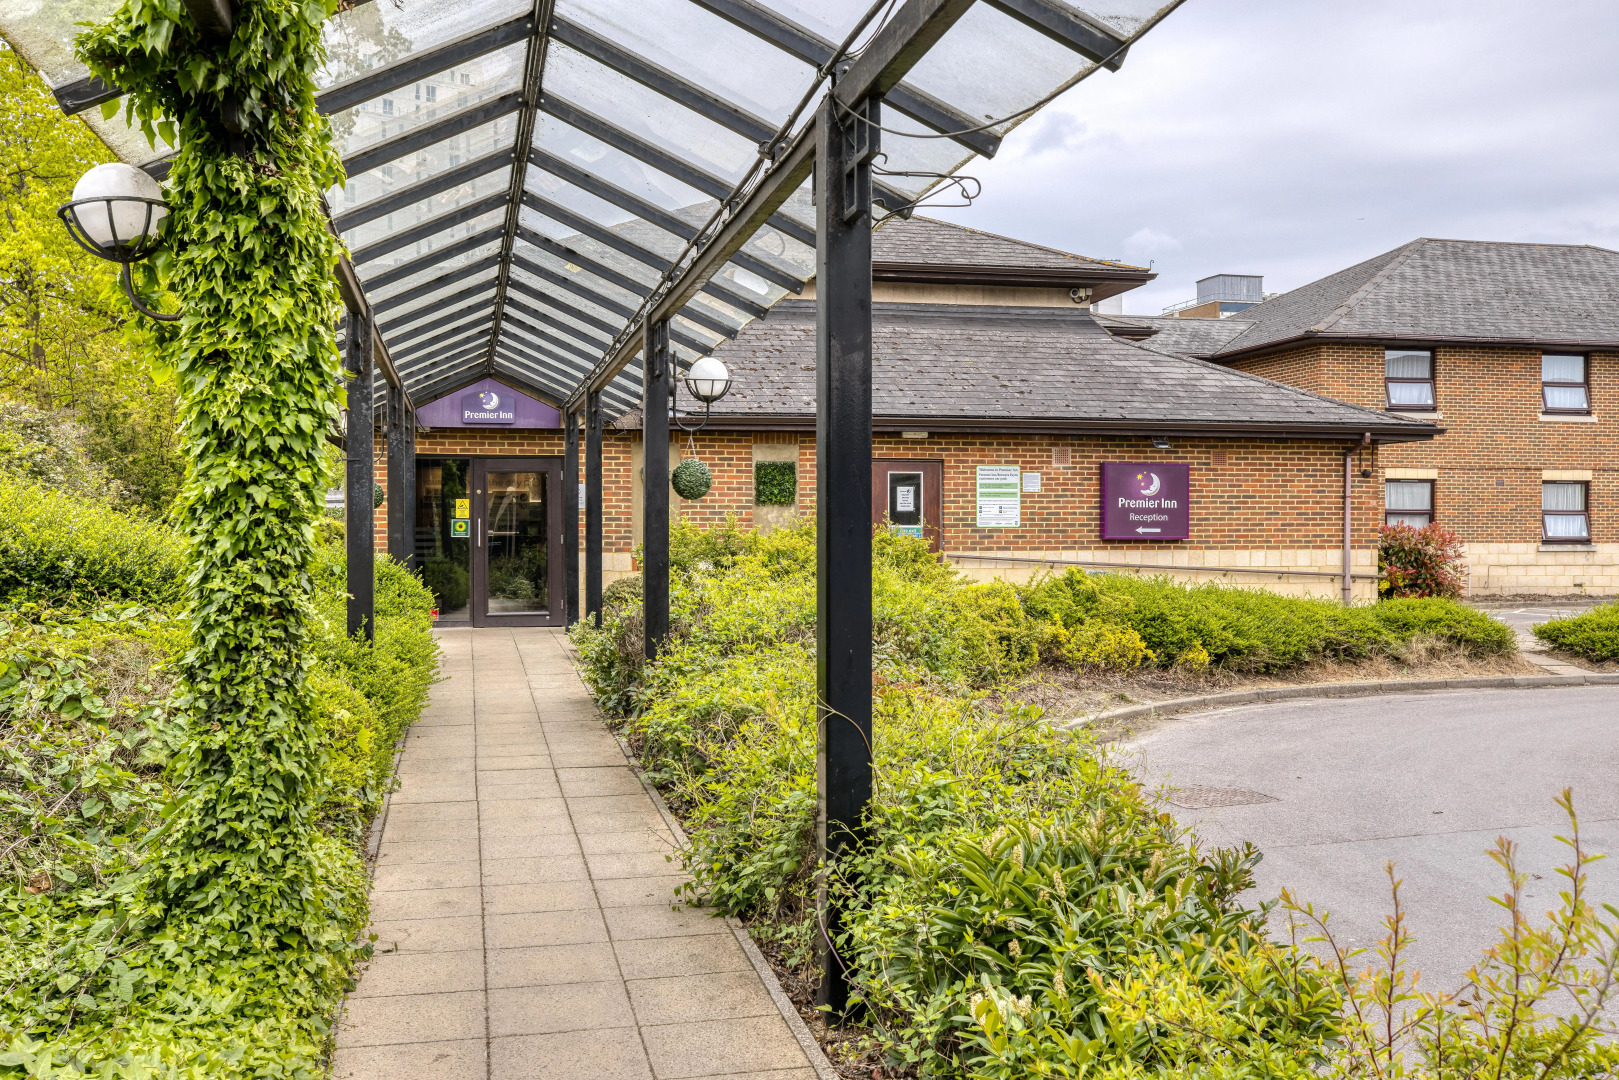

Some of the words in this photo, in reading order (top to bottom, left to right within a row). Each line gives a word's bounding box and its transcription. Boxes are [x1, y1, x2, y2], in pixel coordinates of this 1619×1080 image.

[1118, 498, 1160, 508] Premier
[1161, 498, 1177, 508] Inn
[1130, 513, 1168, 522] Reception
